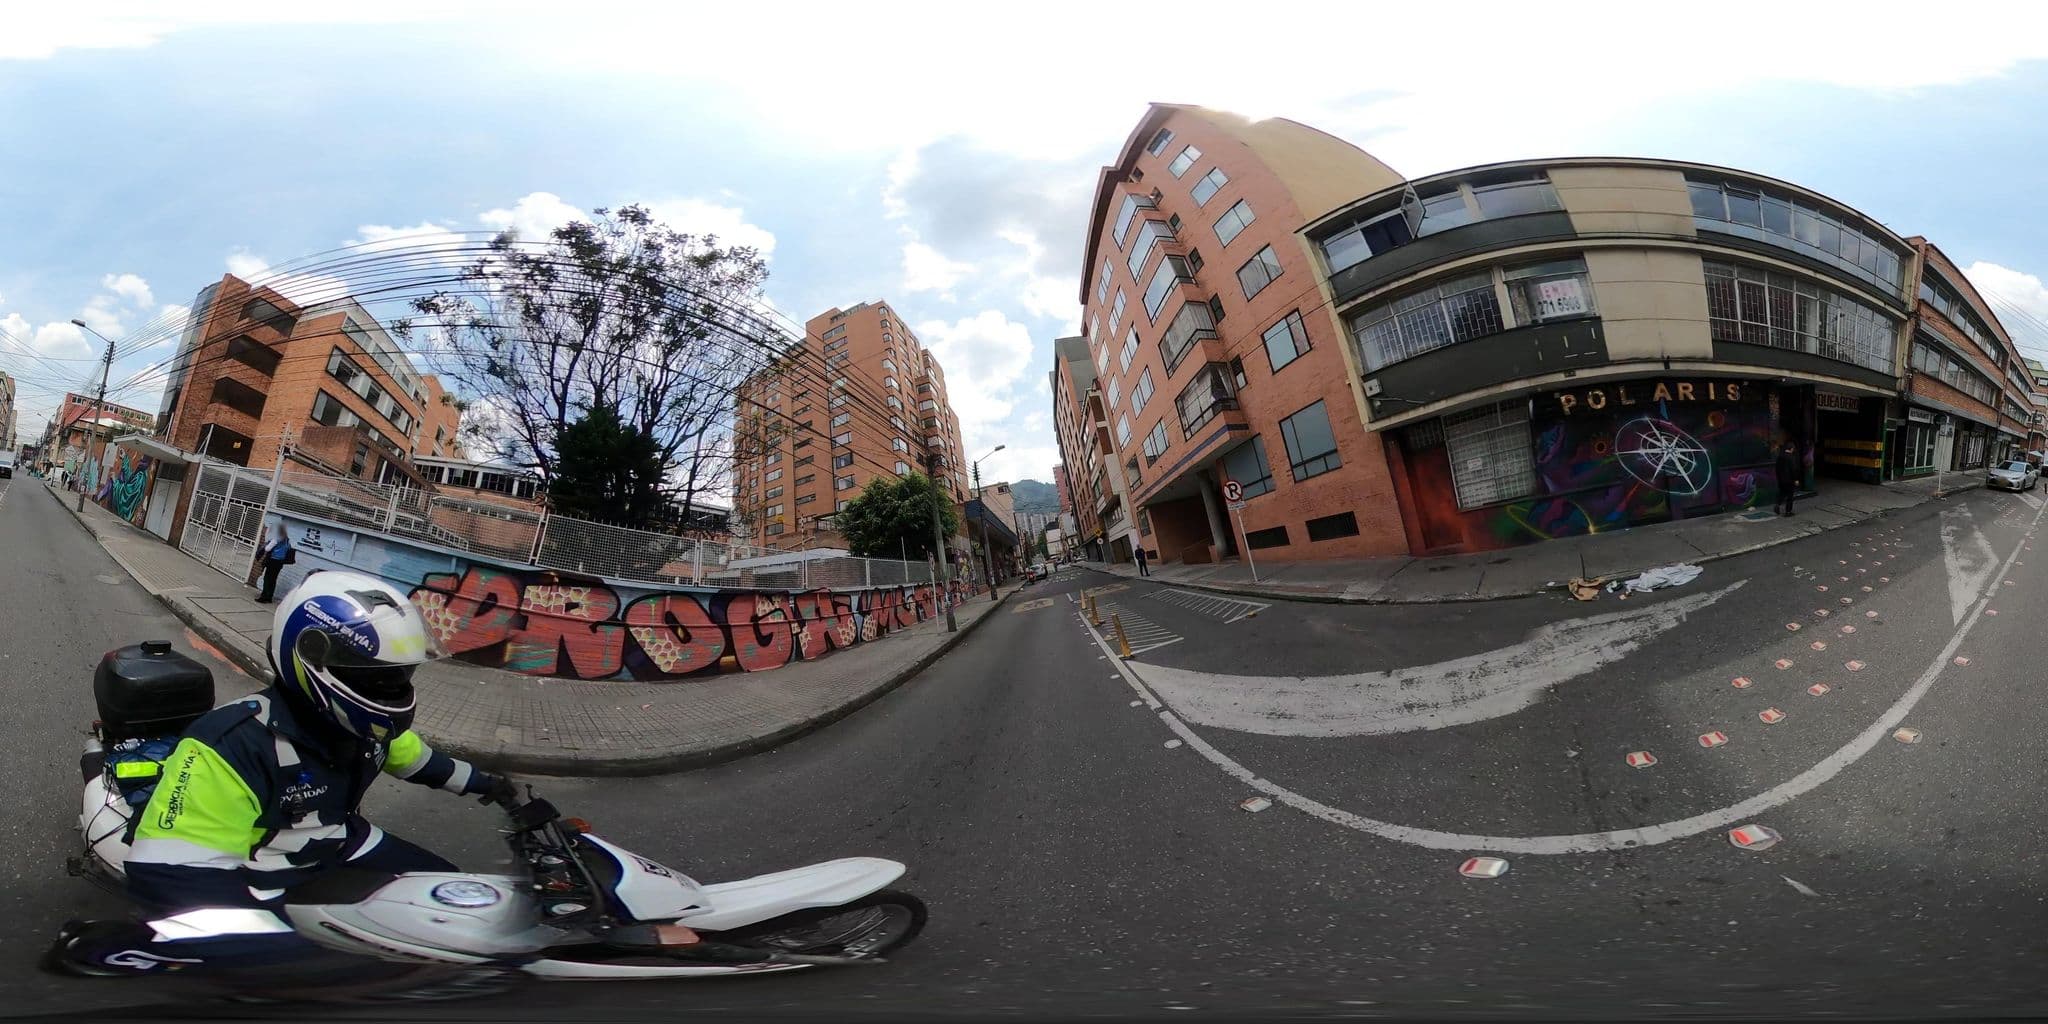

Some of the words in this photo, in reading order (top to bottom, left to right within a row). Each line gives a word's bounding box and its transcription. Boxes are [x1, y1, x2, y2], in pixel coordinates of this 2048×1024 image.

[1559, 382, 1740, 416] POLARIS
[304, 600, 341, 630] GERENCIA
[158, 785, 183, 830] GERENCIA
[178, 771, 187, 784] EN
